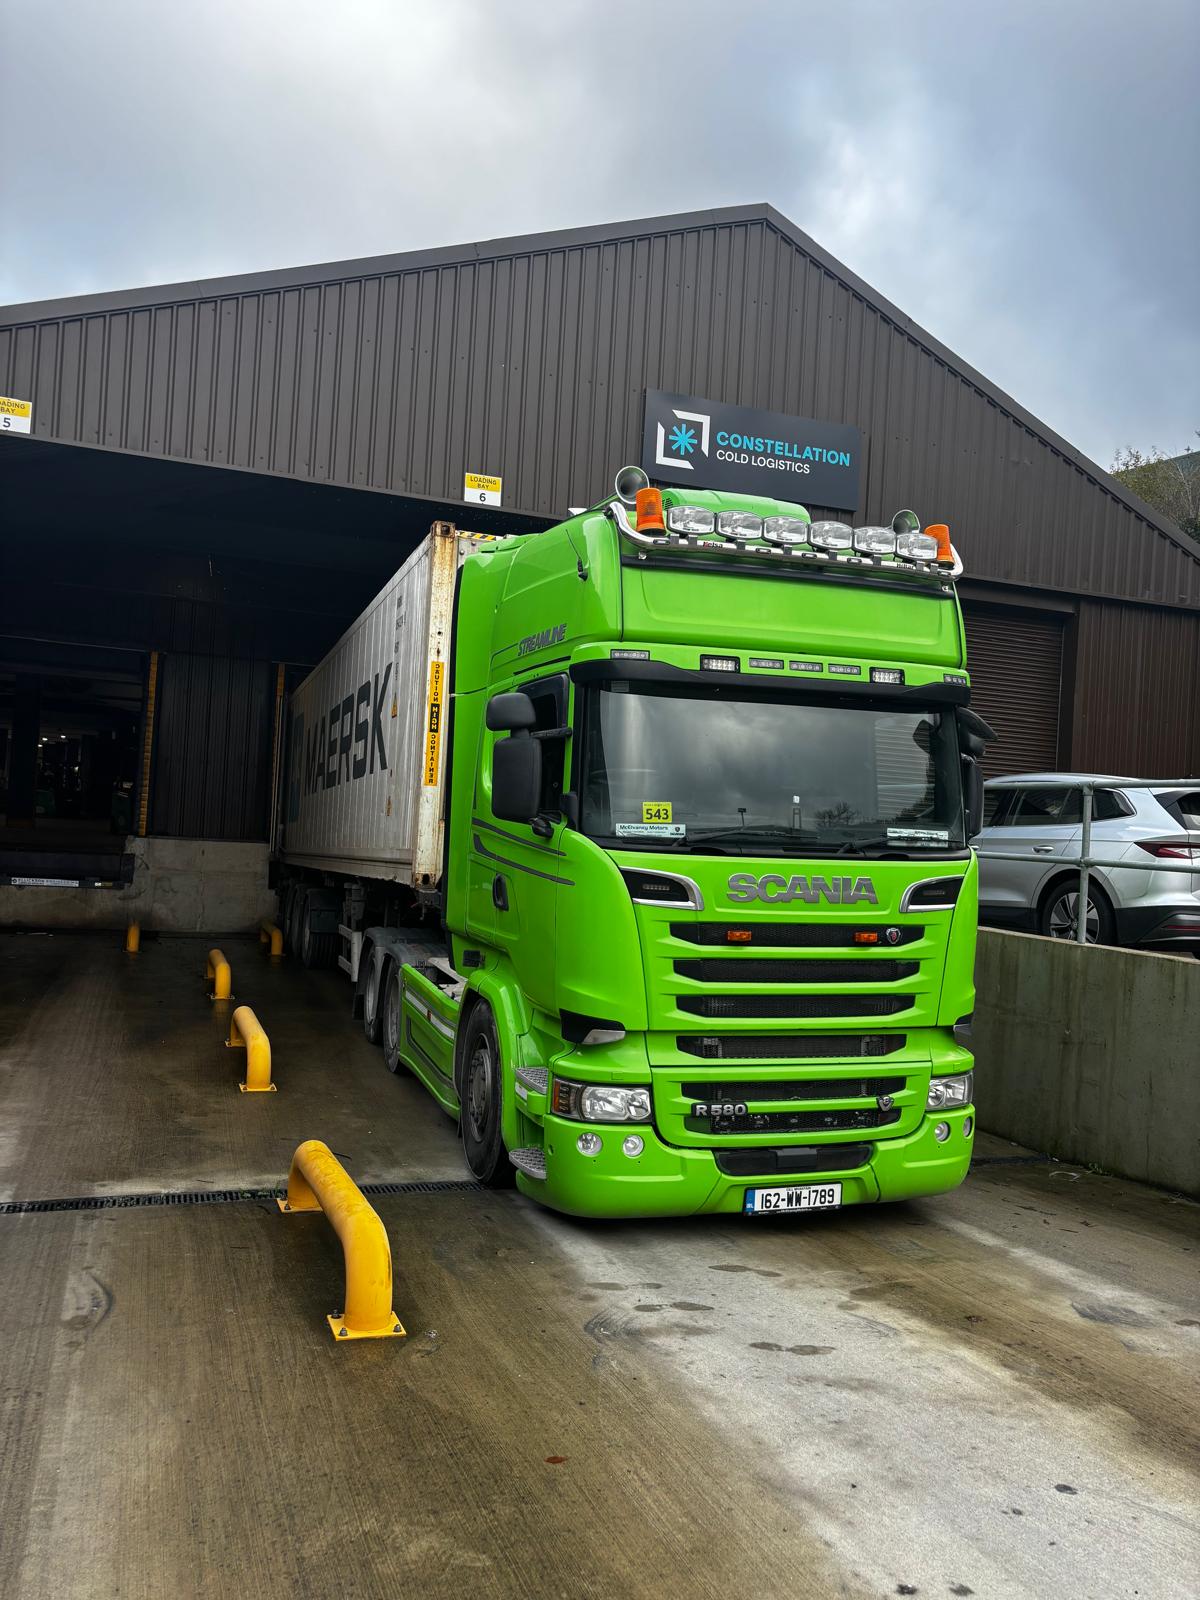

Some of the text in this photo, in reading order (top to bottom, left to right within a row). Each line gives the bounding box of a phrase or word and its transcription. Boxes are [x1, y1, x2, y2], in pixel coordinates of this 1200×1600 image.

[0, 400, 26, 410] ADING
[0, 406, 16, 414] BAY
[3, 417, 11, 428] 5
[716, 431, 850, 467] CONSTELLATION
[716, 450, 810, 474] COLD LOGISTICS
[470, 476, 497, 486] LOADING
[479, 492, 487, 502] 6
[518, 623, 567, 656] STREAMLINE
[304, 662, 393, 797] MAERSK
[645, 808, 669, 820] 543
[726, 873, 879, 905] SCANIA
[695, 1104, 747, 1116] R 580
[761, 1188, 835, 1210] 162-WW-1789
